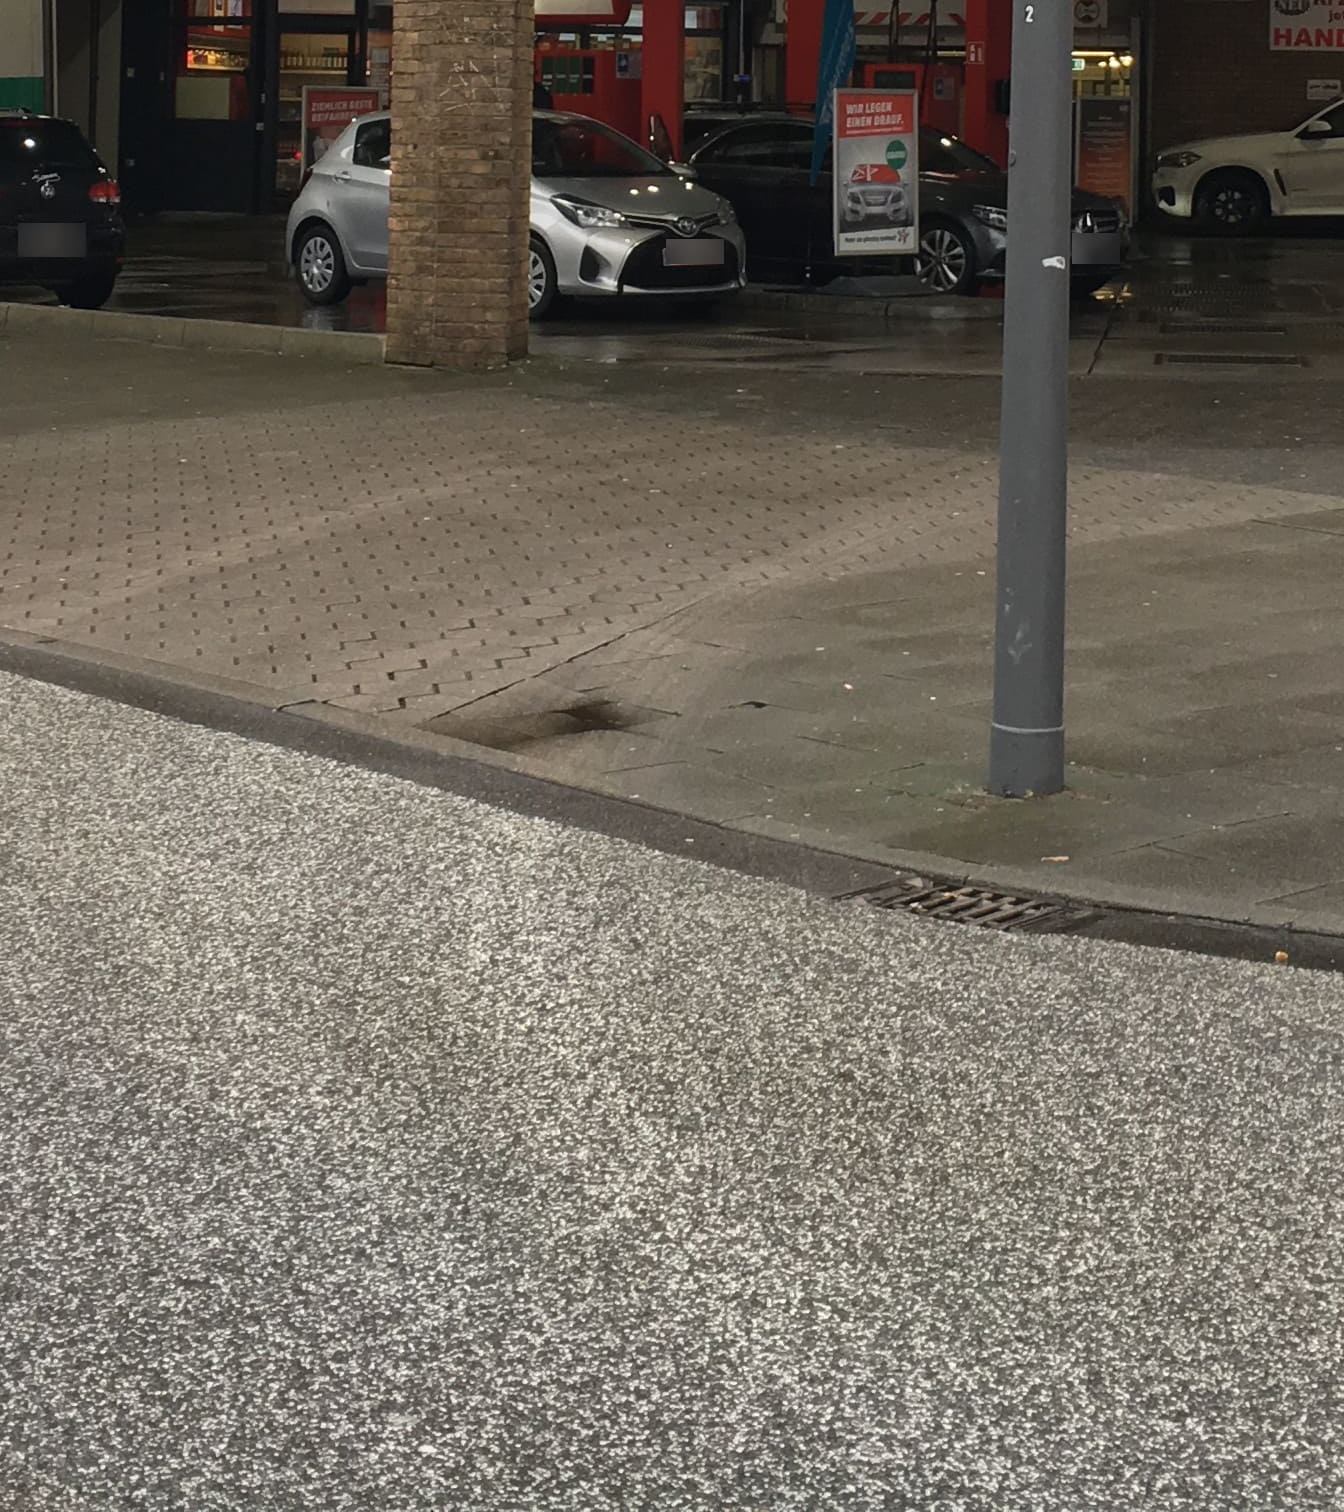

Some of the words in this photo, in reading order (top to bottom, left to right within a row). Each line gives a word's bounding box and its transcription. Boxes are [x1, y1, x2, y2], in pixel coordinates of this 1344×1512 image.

[1024, 5, 1034, 22] 2
[845, 103, 864, 115] WIR
[865, 101, 893, 114] LEGEN
[846, 115, 873, 128] EINEN
